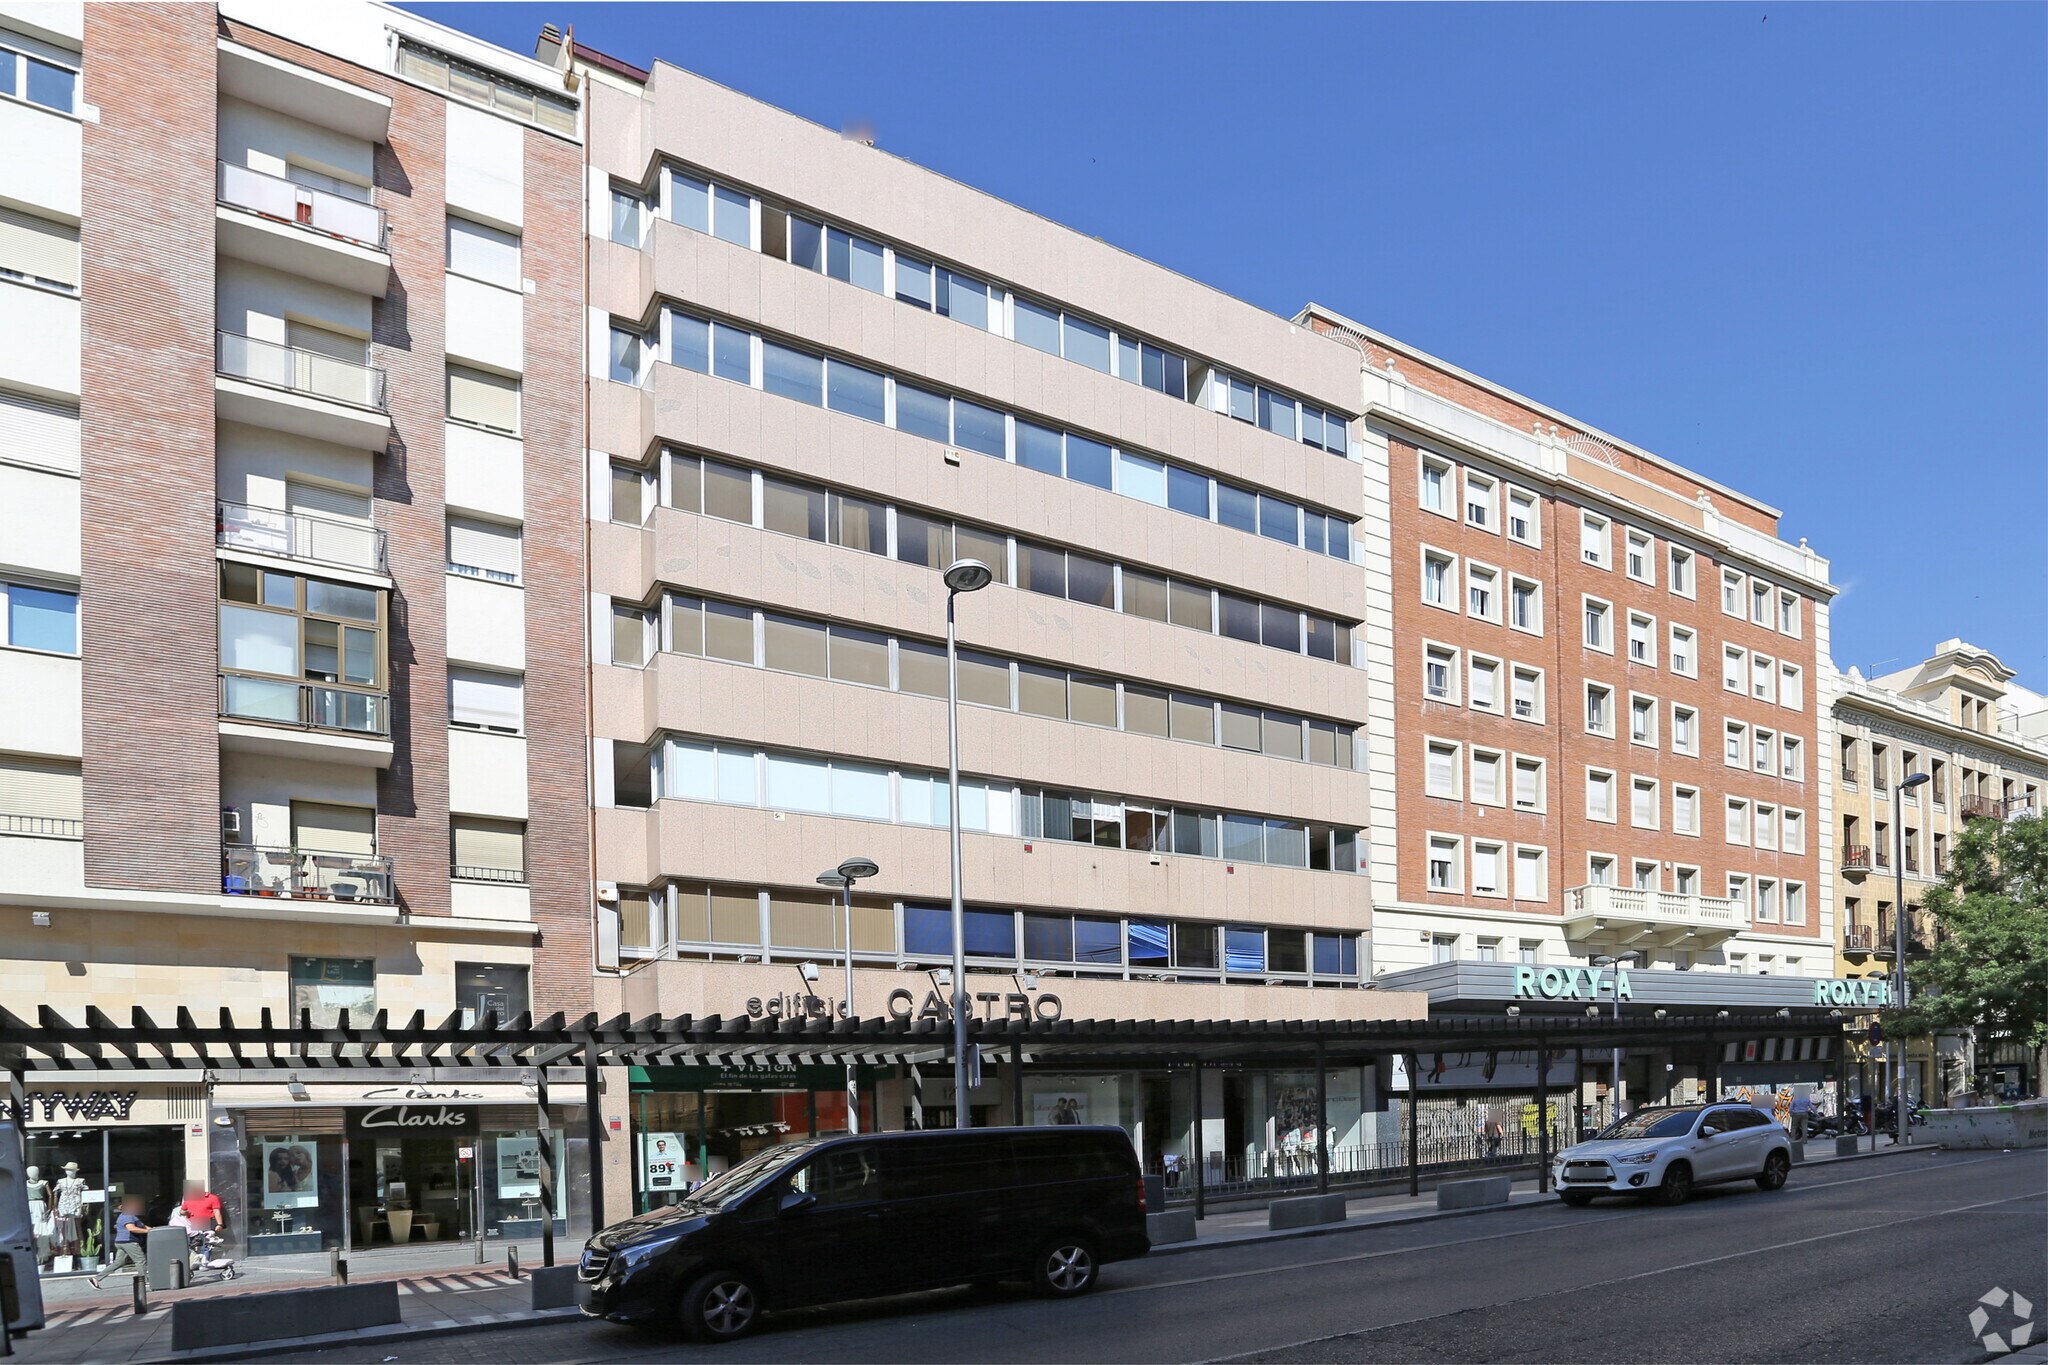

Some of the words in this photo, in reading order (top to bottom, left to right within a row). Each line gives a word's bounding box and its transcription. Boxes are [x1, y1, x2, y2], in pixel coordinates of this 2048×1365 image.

[1514, 966, 1633, 1000] ROXY-A
[1814, 980, 1892, 1005] ROXY-B
[887, 987, 1063, 1022] CASTRO
[362, 1088, 484, 1099] Clarks
[361, 1105, 467, 1128] Clarks
